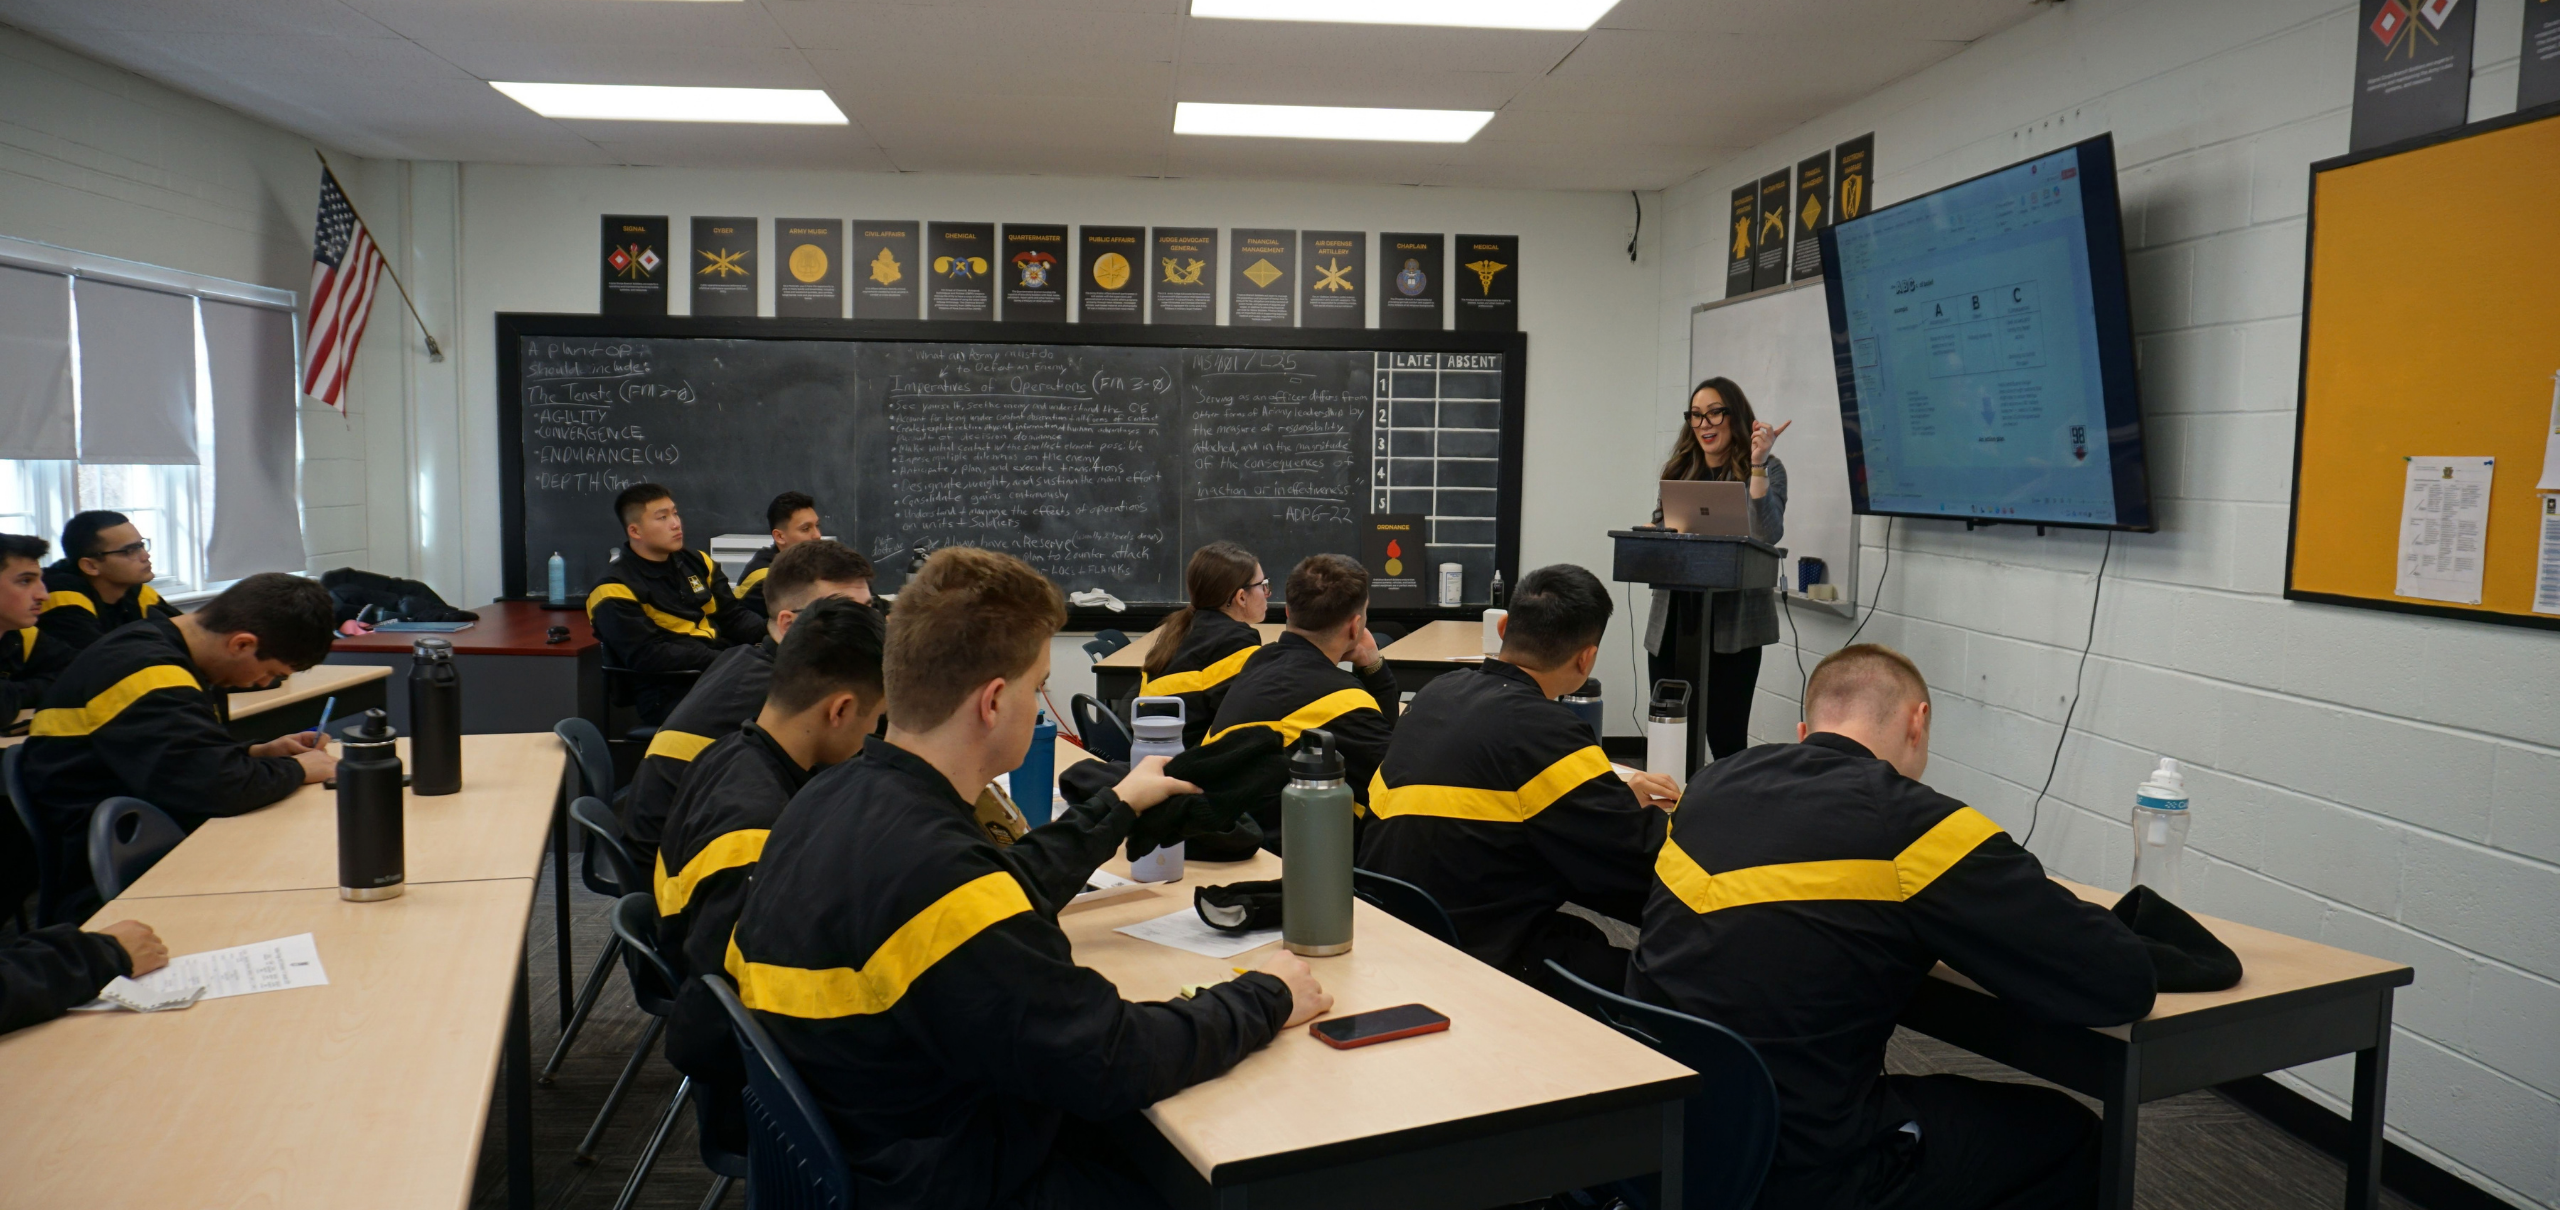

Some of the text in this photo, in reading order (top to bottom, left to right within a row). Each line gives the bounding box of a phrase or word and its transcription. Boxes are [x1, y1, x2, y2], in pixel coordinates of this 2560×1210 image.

[945, 232, 976, 240] CHEMICAL
[1008, 234, 1061, 242] QUARTERMASTER
[1110, 236, 1136, 244] AFFAIRS
[1247, 238, 1280, 246] FINANCIAL
[1170, 244, 1198, 252] GENERAL
[1241, 246, 1284, 254] MANAGEMENT
[1935, 288, 2022, 317] A B C
[528, 341, 538, 356] A
[1396, 354, 1496, 368] LATE ABSENT
[890, 375, 971, 397] Imperatives
[981, 378, 996, 392] of
[1010, 376, 1086, 394] Operations
[1380, 378, 1386, 391] 1
[528, 386, 556, 404] The
[560, 382, 613, 403] Tenets
[1268, 390, 1306, 402] officer
[895, 401, 916, 410] See
[540, 409, 606, 425] AGILITY
[1378, 409, 1386, 422] 2
[538, 426, 645, 442] CONVERGENCE
[1192, 424, 1214, 436] the
[1217, 424, 1256, 435] measure
[2072, 426, 2086, 444] 98
[1262, 442, 1274, 452] in
[1276, 440, 1292, 452] the
[1378, 438, 1385, 450] 3
[1220, 456, 1239, 469] the
[1126, 471, 1162, 483] effort
[1377, 466, 1386, 478] 4
[1198, 482, 1270, 496] inaction or
[1090, 500, 1148, 516] operations
[1378, 498, 1386, 509] 5
[980, 535, 1071, 552] have Reserve
